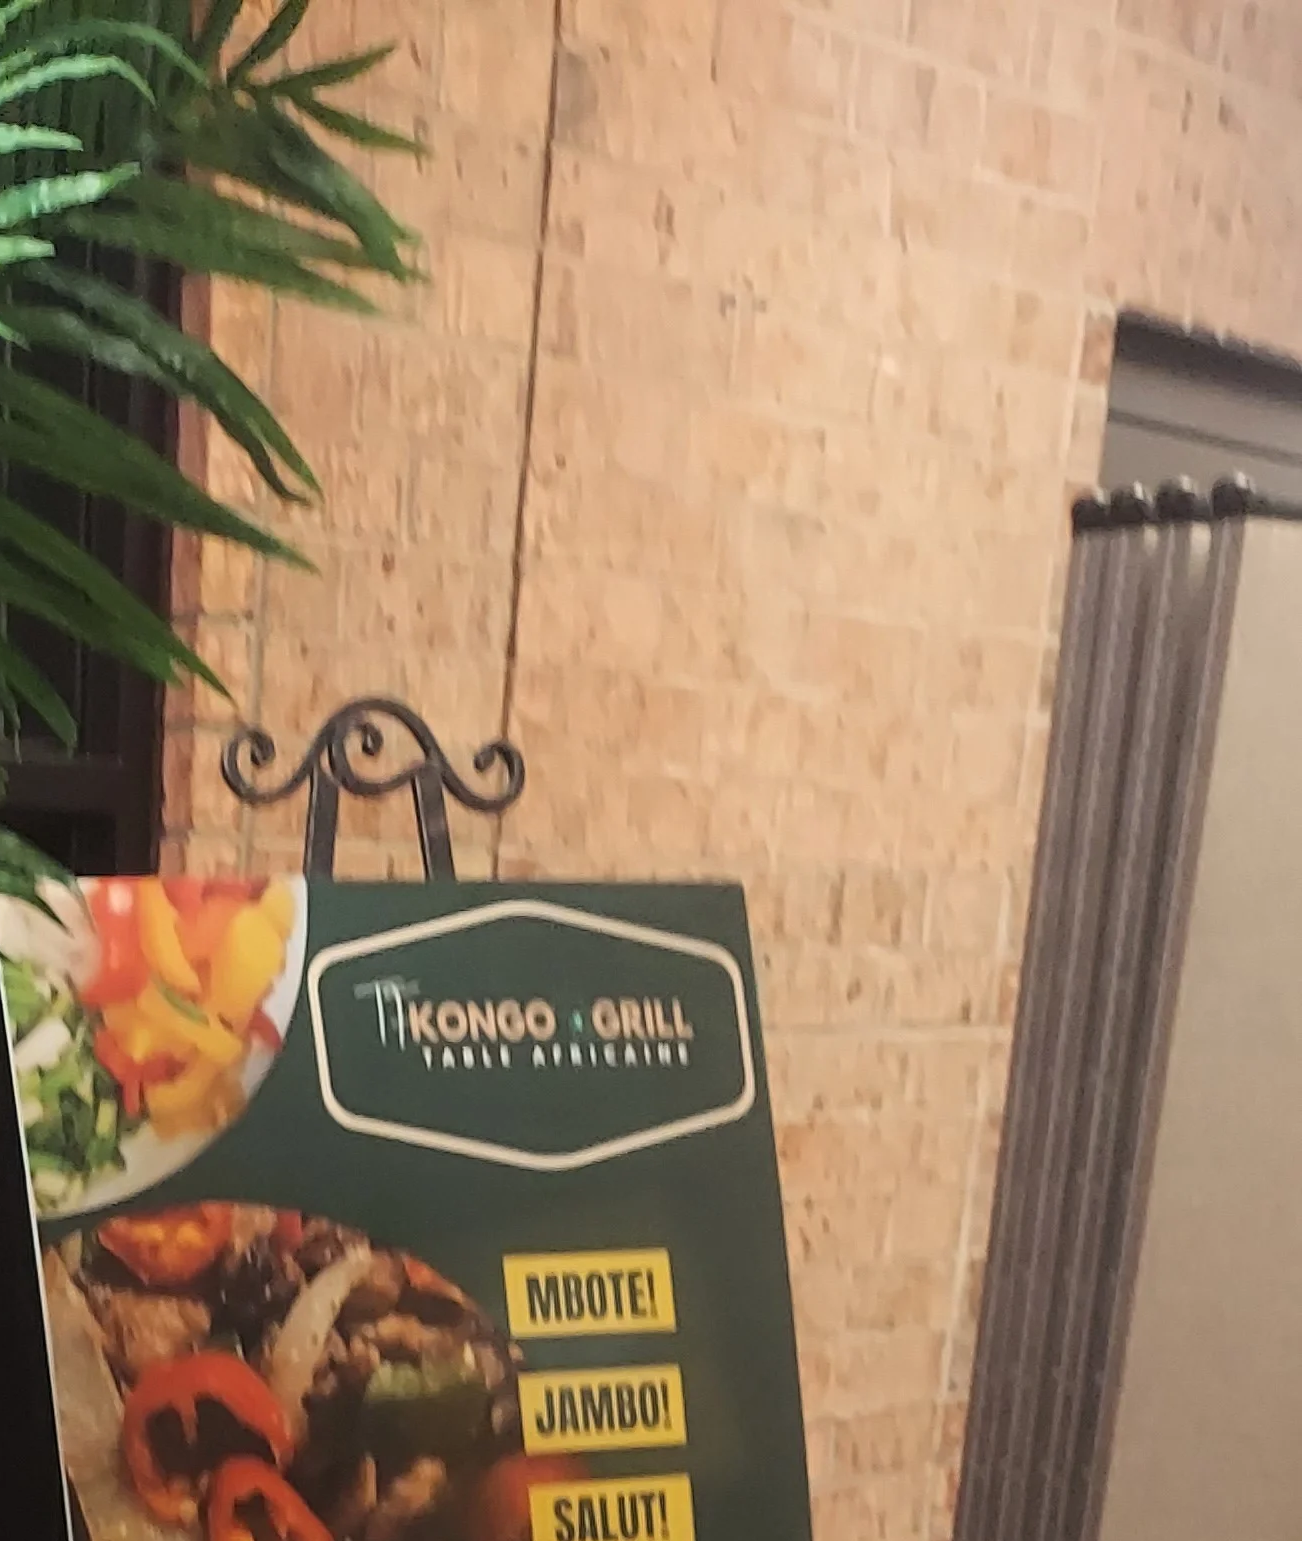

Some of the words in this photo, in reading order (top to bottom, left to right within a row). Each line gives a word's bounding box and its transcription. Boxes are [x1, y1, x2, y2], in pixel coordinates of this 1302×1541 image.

[408, 998, 556, 1043] KONGO
[591, 996, 694, 1041] GRILL
[526, 1270, 657, 1325] MBOTE!
[536, 1379, 671, 1437] JAMBO!
